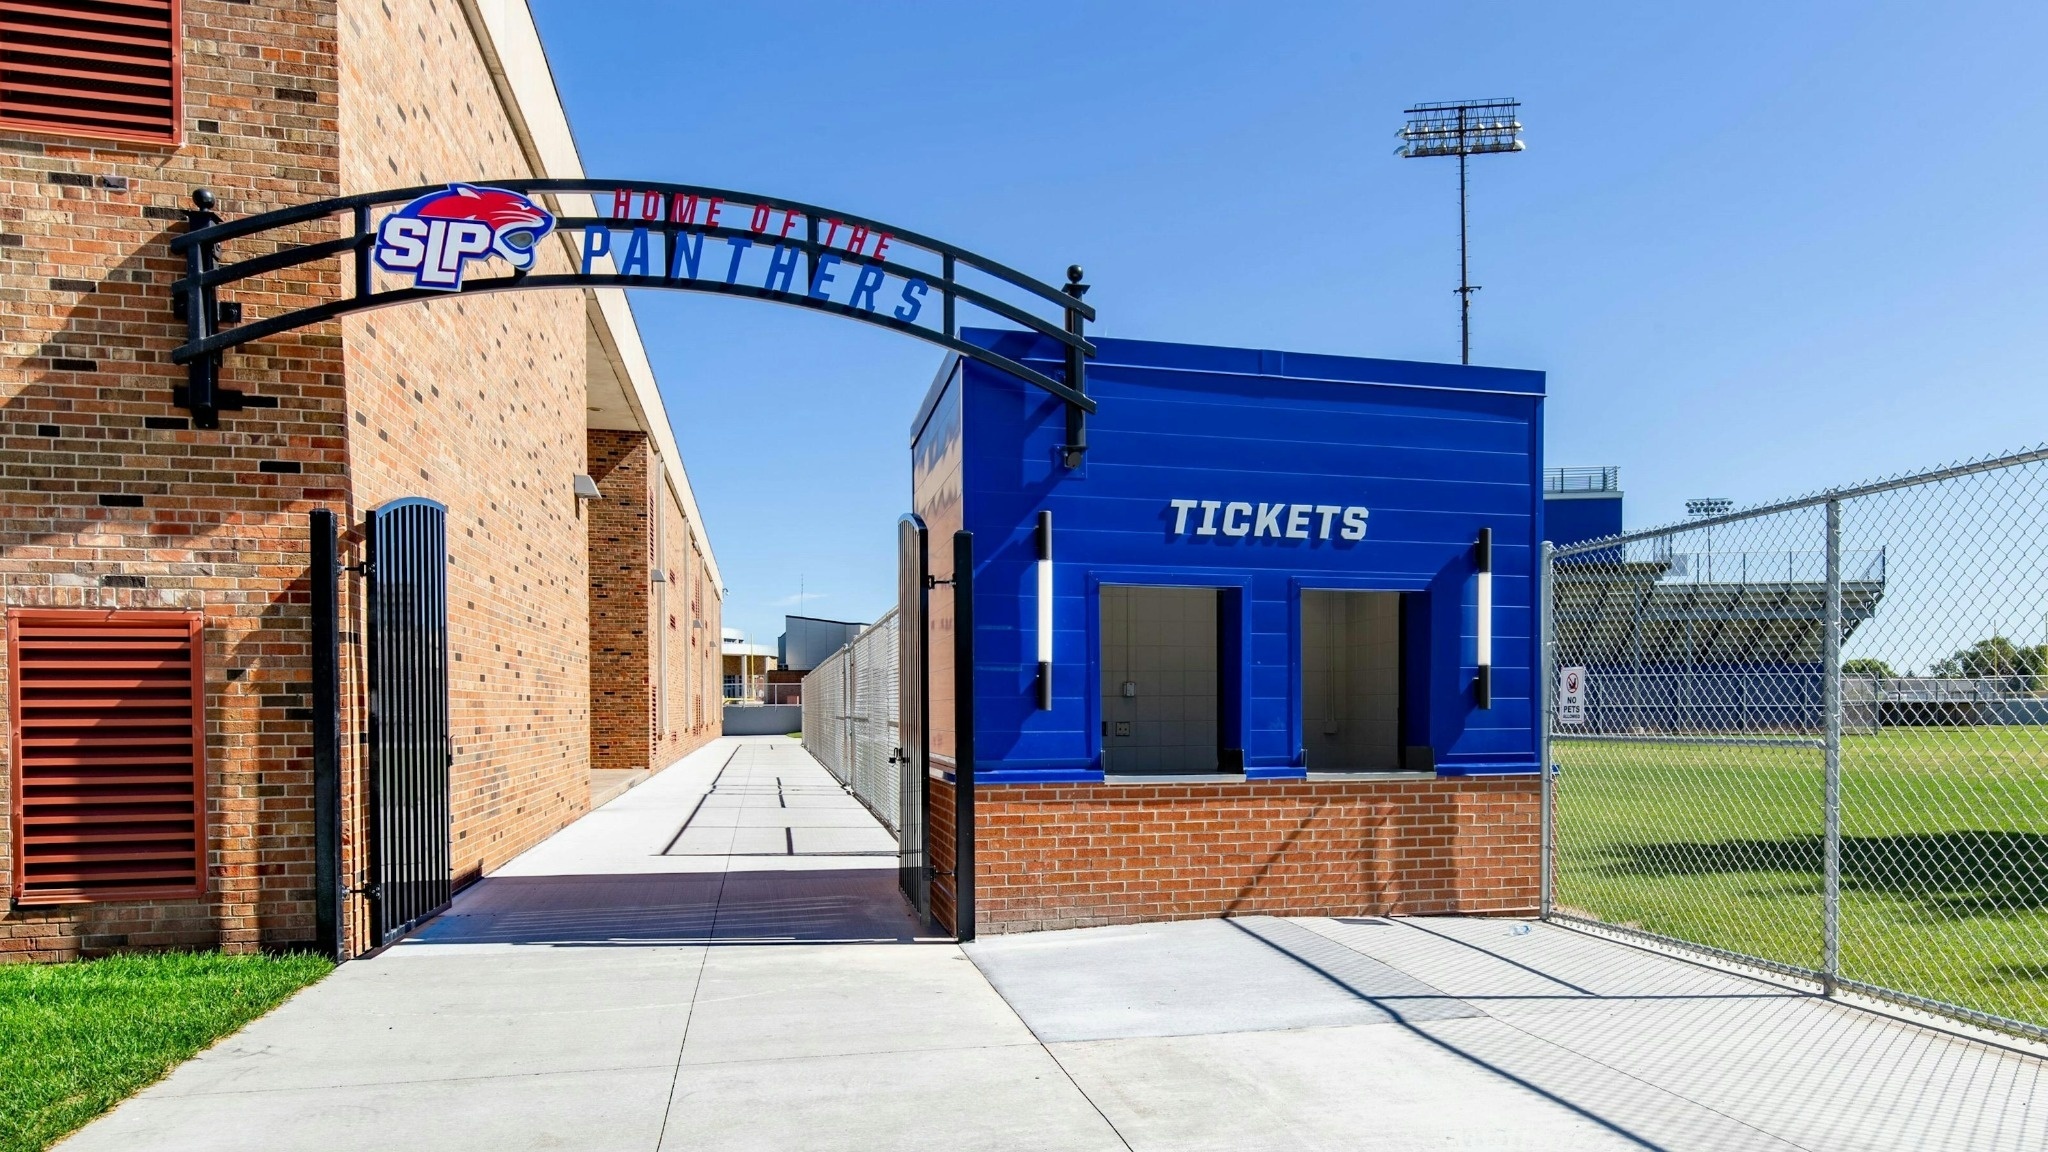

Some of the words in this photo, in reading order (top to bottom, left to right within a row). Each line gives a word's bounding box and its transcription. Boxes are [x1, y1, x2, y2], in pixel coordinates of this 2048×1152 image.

[380, 217, 491, 283] SLP
[612, 188, 725, 228] HOME
[750, 203, 801, 239] OF
[825, 217, 895, 262] THE
[581, 225, 929, 323] PANTHERS
[1170, 499, 1370, 541] TICKETS
[1563, 705, 1580, 713] PETS
[1567, 696, 1577, 704] NO
